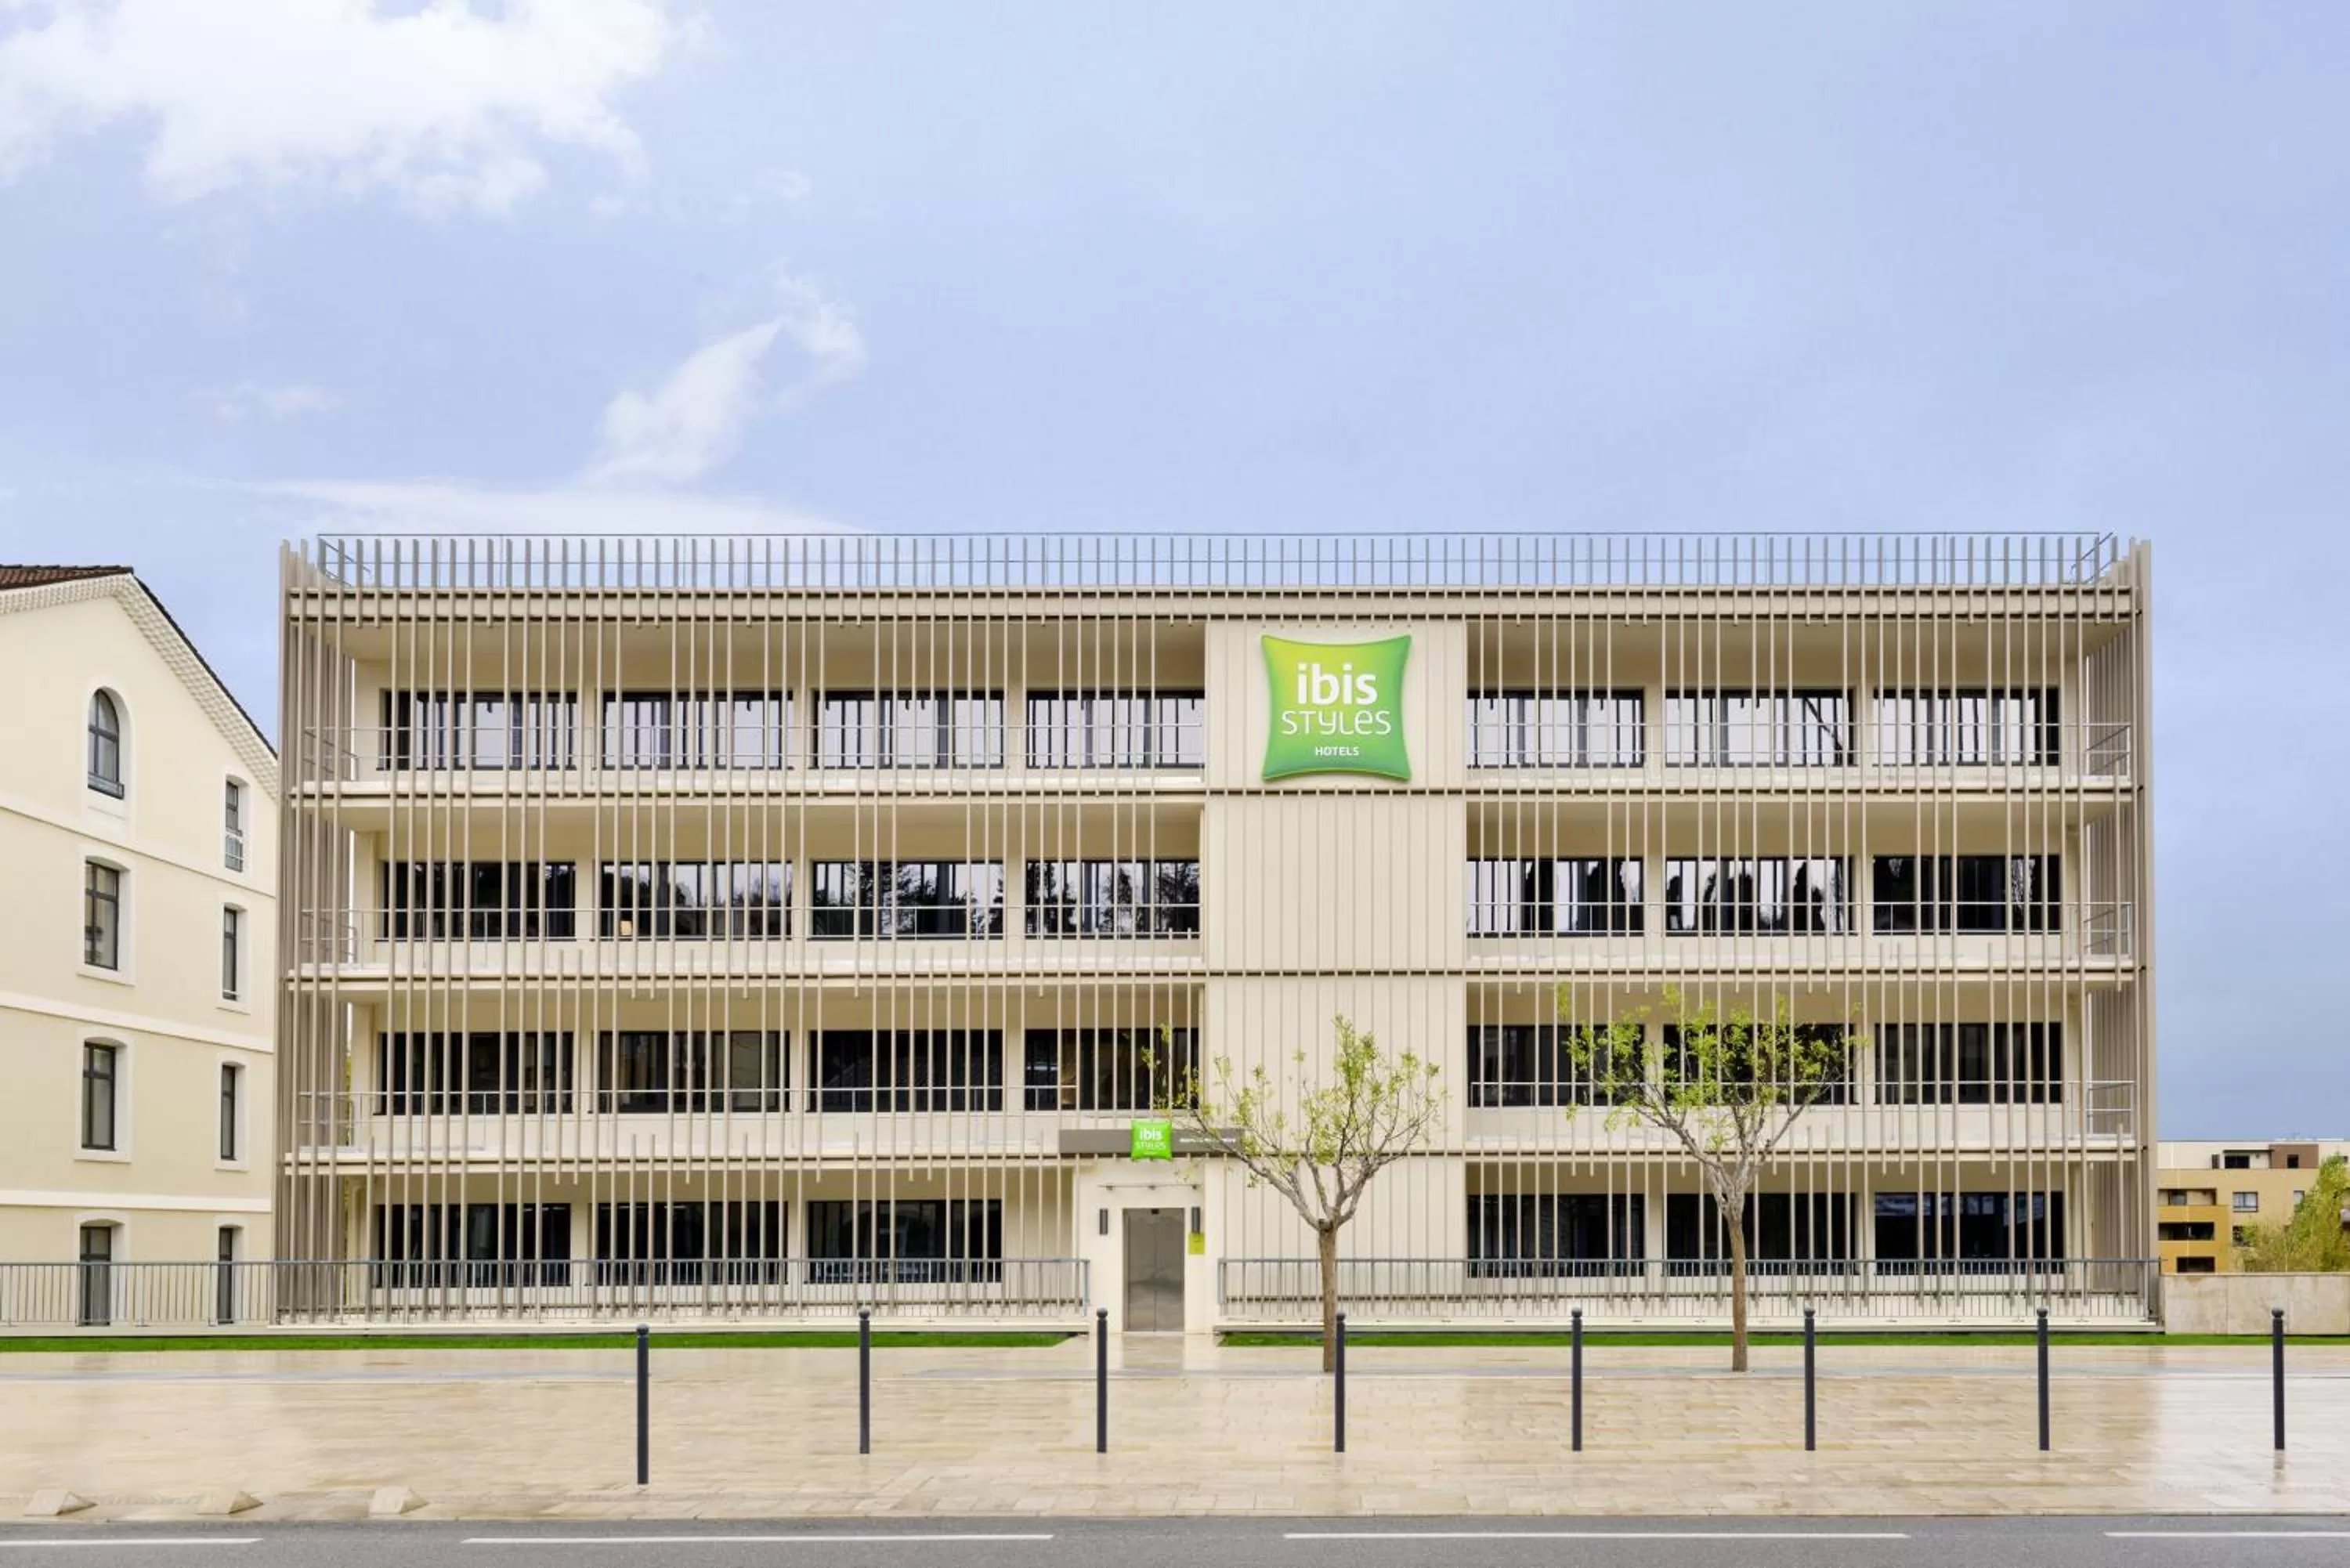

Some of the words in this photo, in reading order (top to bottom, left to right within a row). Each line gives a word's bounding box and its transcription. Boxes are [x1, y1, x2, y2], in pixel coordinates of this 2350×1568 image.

[1297, 663, 1378, 705] ibis
[1315, 746, 1359, 756] HOTELS
[1140, 1128, 1162, 1140] ibis
